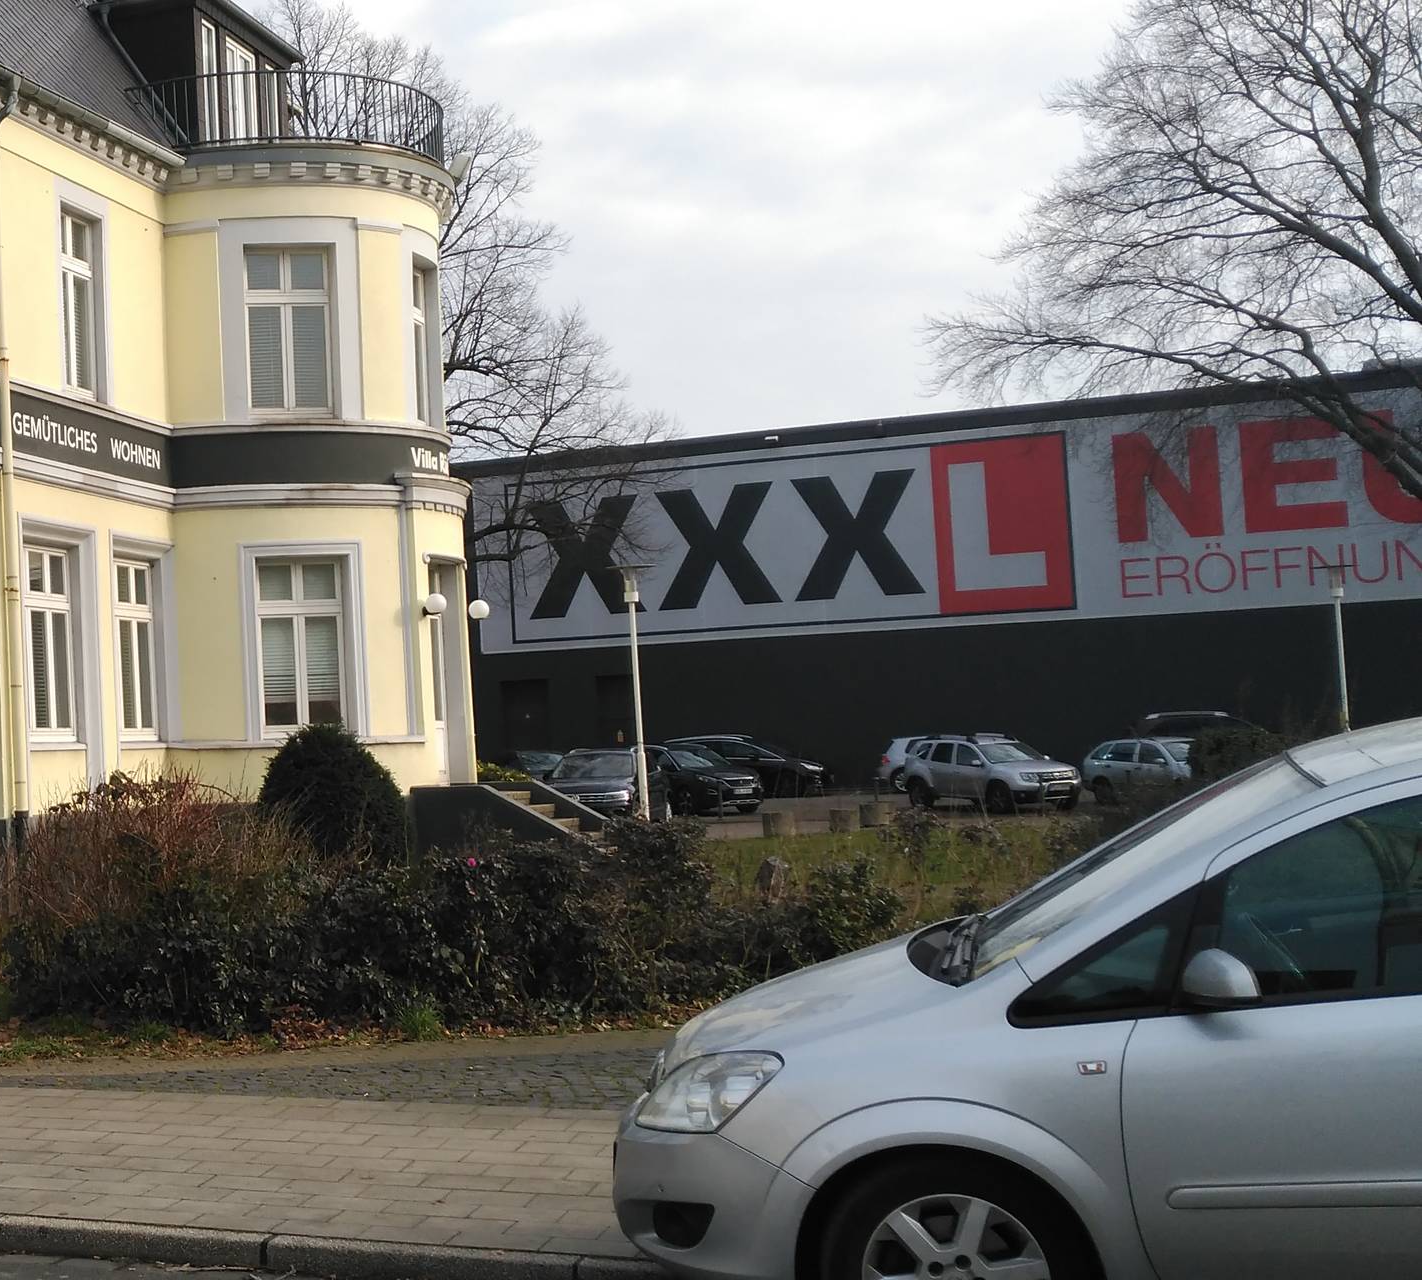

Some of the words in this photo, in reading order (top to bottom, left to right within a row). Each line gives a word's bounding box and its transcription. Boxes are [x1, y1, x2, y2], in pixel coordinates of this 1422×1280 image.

[12, 412, 98, 454] GEMÜTLICHES
[110, 437, 161, 470] WOHNEN
[410, 446, 438, 471] Villa
[527, 460, 1049, 620] XXXL
